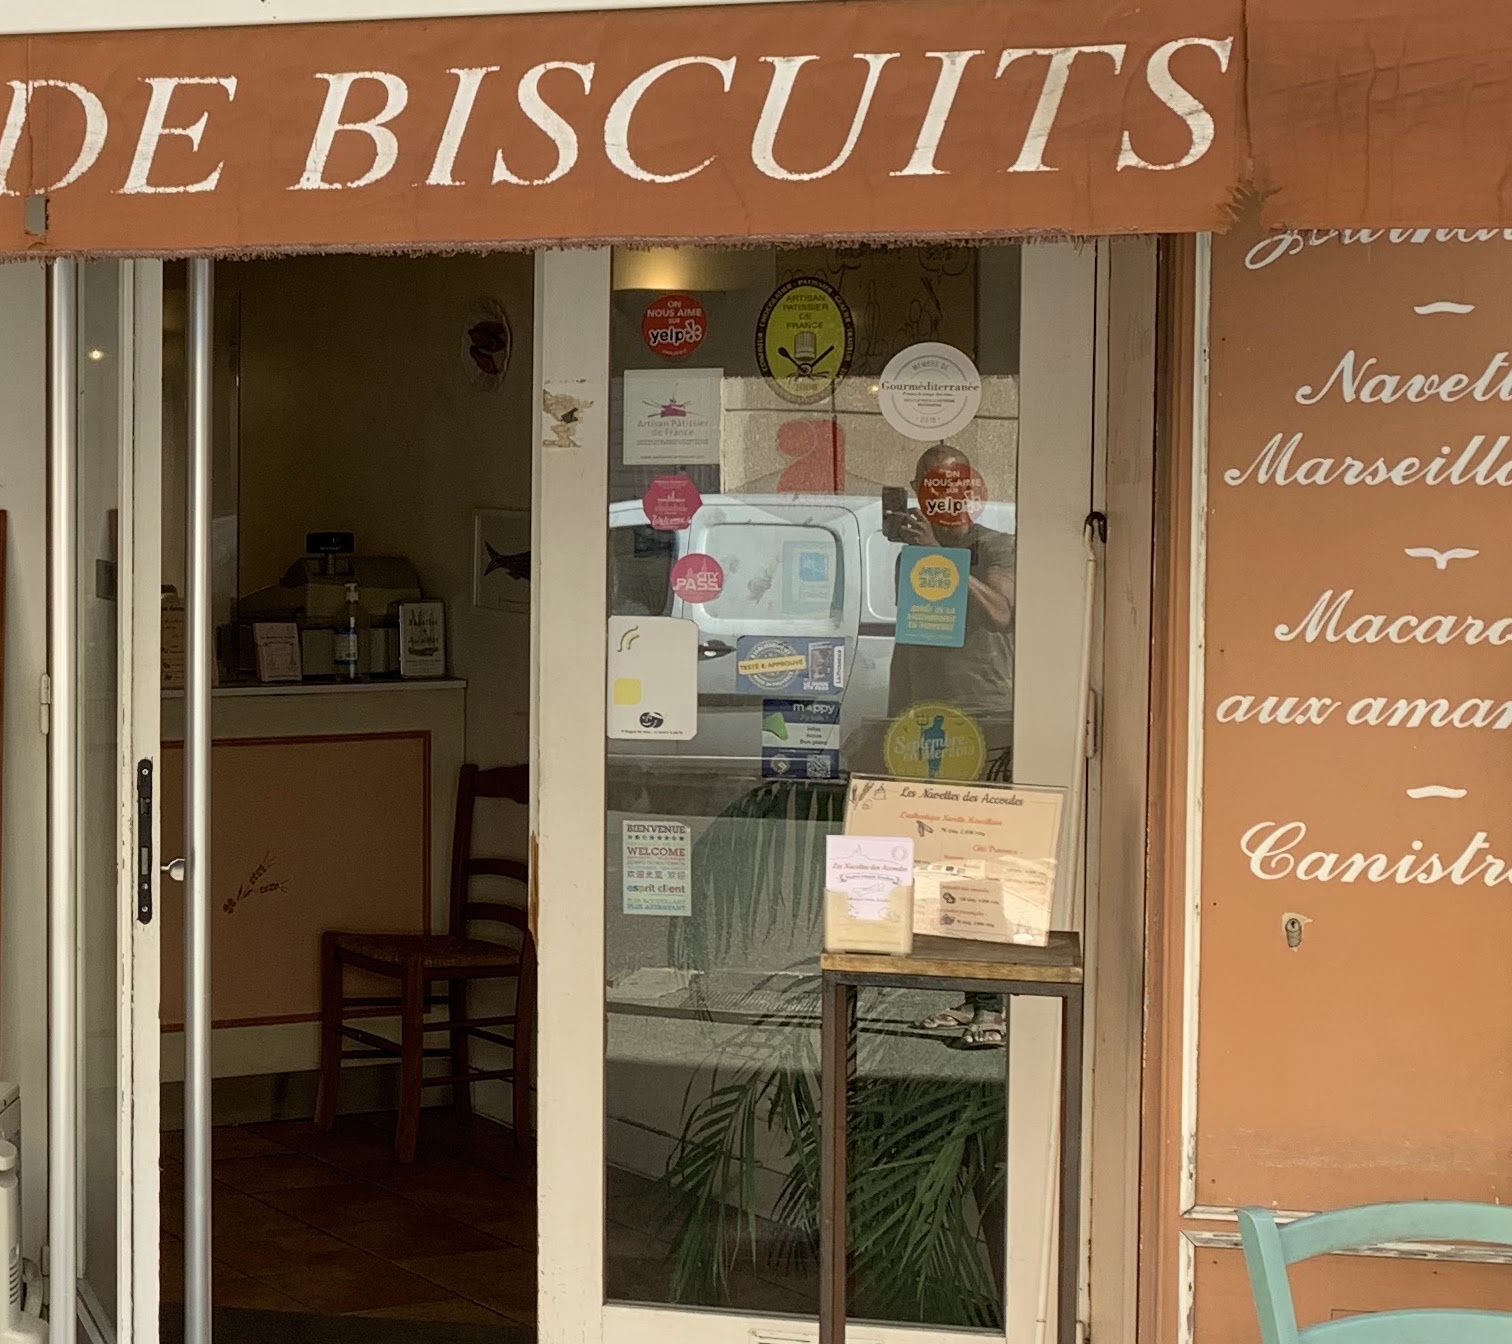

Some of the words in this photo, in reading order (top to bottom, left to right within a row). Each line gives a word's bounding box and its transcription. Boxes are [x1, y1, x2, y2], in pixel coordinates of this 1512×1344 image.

[286, 35, 1233, 190] BISCUITS
[786, 294, 826, 302] ARTISAN
[667, 300, 682, 308] ON
[647, 308, 675, 317] NOUS
[677, 308, 702, 317] AIME
[798, 312, 812, 320] DE
[786, 321, 824, 329] FRANCE
[649, 326, 685, 346] yelp
[912, 359, 939, 371] MEMBRE
[637, 419, 669, 427] Artisan
[671, 419, 709, 428] Pâtissier
[651, 428, 663, 436] de
[665, 428, 694, 436] France
[945, 470, 960, 478] ON
[924, 478, 953, 487] NOUS
[955, 478, 982, 487] AIME
[926, 496, 964, 516] yelp
[696, 571, 719, 580] CITY
[675, 577, 720, 591] PASS
[768, 659, 804, 668] APPROUVÉ
[1216, 694, 1342, 725] aux
[900, 786, 916, 798] Les
[918, 788, 960, 801] Navettes
[962, 791, 979, 803] des
[982, 793, 1024, 806] Accoules
[626, 824, 686, 834] BIENVENUE
[626, 846, 686, 857] WELCOME
[1240, 821, 1512, 887] Canistr
[657, 884, 686, 893] client
